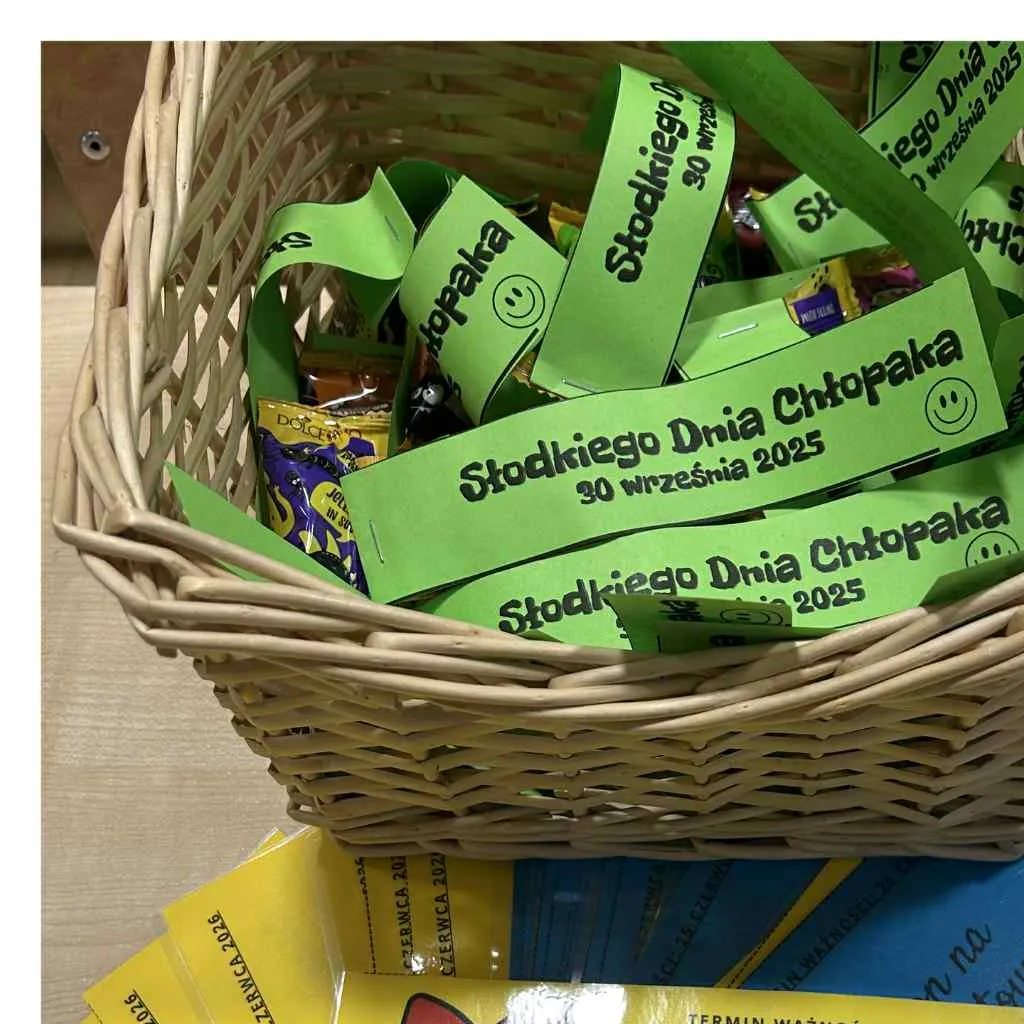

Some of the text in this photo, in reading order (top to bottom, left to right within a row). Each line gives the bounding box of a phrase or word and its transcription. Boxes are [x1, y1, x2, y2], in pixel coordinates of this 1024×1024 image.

[926, 41, 1022, 180] września 2025
[936, 41, 986, 117] Dnia
[605, 100, 689, 283] Słodkiego
[682, 155, 711, 191] 30
[459, 329, 964, 502] Słodkiego Dnia Chłopaka
[576, 430, 826, 505] 30 września 2025
[499, 496, 1011, 634] Słodkiego Dnia Chłopaka
[793, 578, 866, 614] 2025
[207, 911, 237, 952] 2026
[435, 893, 455, 977] CZERWCA
[949, 922, 993, 974] na
